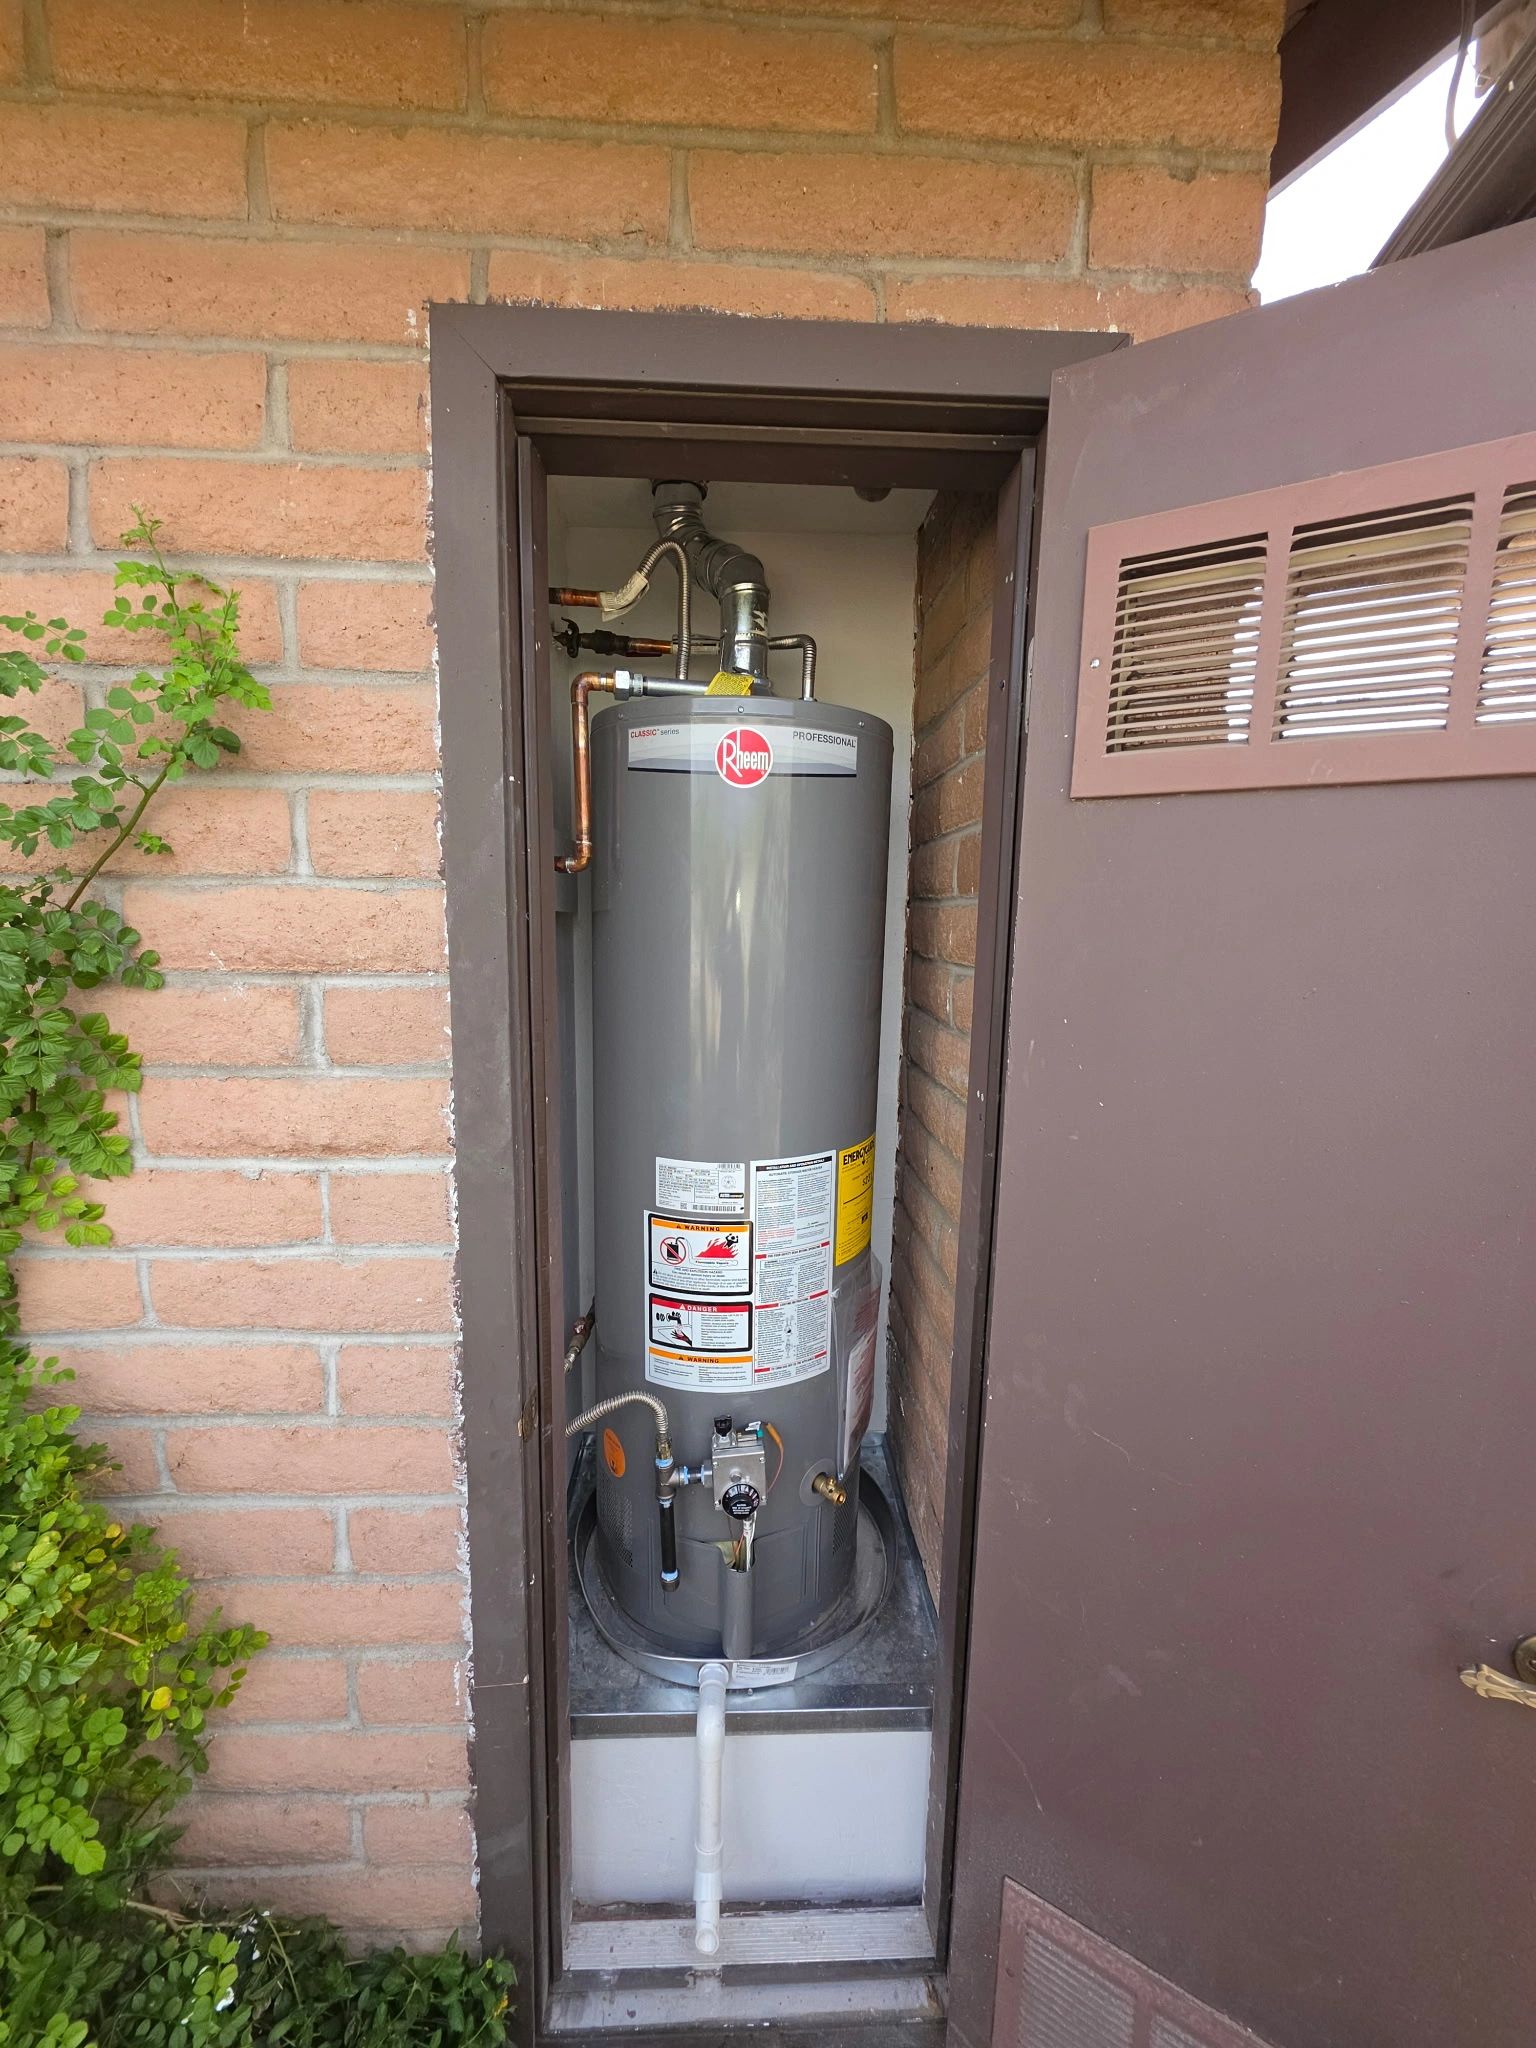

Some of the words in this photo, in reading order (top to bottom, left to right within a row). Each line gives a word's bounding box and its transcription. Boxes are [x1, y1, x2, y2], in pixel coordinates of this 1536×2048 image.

[660, 728, 680, 736] series
[792, 730, 856, 748] PROFESSIONAL
[722, 729, 769, 778] Rheem
[687, 1304, 718, 1312] DANGER
[687, 1356, 719, 1364] WARNING
